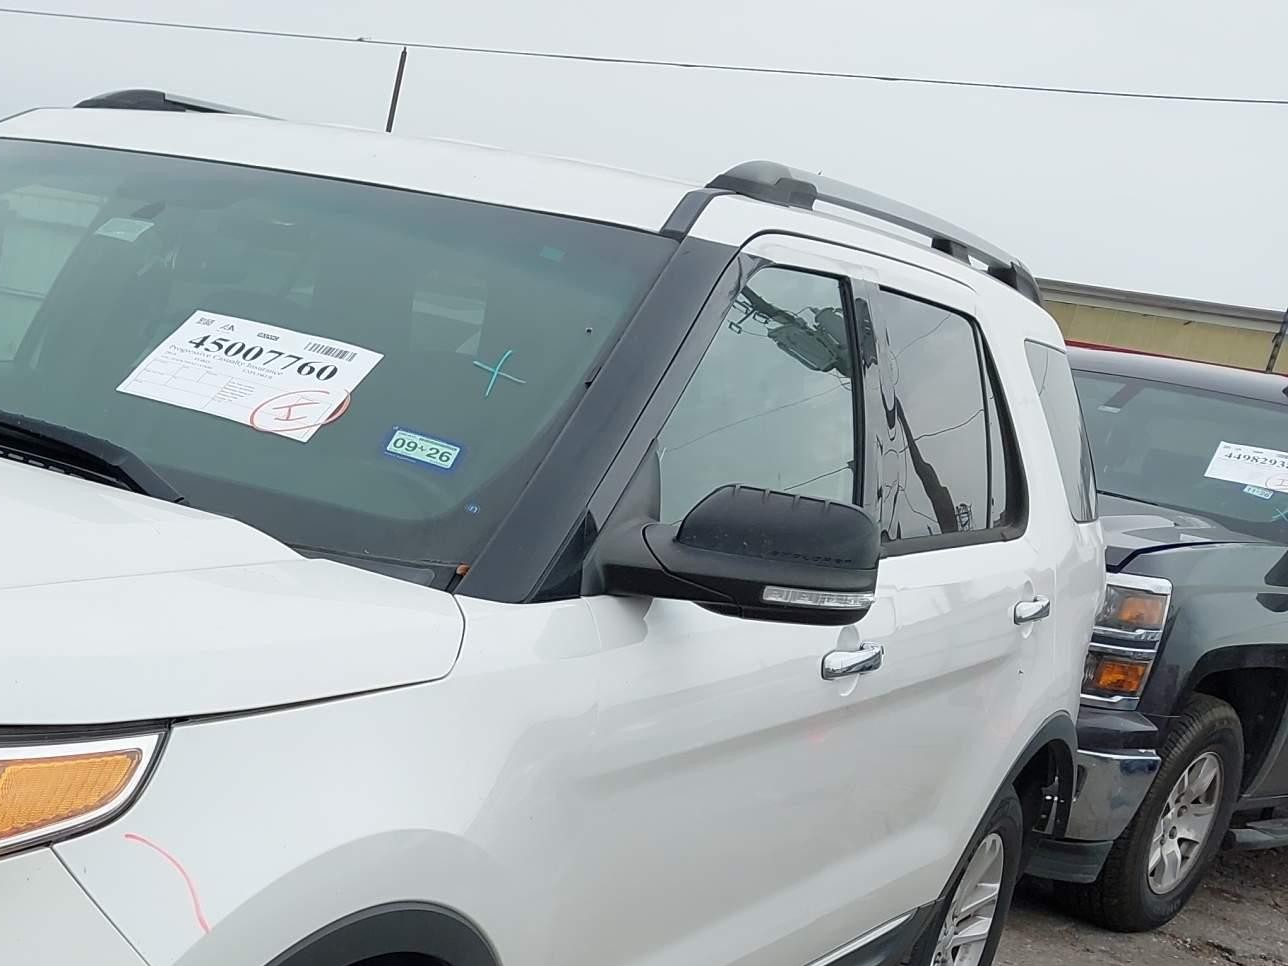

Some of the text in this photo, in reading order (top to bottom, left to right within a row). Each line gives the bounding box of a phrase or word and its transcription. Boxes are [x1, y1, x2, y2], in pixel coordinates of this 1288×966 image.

[188, 334, 339, 382] 45007760
[392, 437, 453, 463] 09 26
[1224, 452, 1288, 469] 4498293
